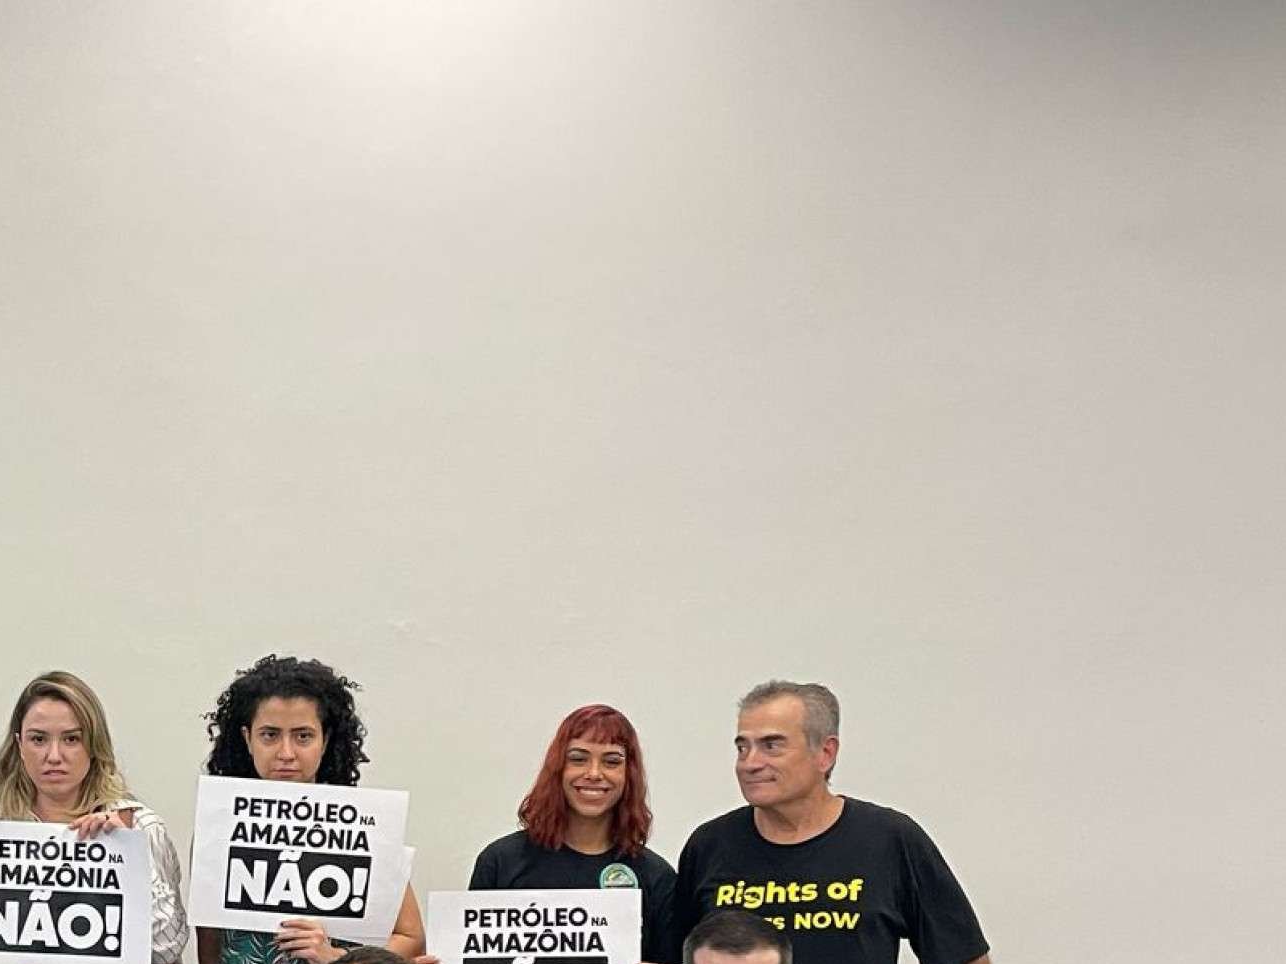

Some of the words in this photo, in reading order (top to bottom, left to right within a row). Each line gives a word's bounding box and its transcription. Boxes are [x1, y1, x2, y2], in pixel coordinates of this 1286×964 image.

[233, 796, 358, 824] PETRÓLEO
[360, 816, 376, 826] NA
[231, 822, 370, 851] AMAZÔNIA
[108, 853, 124, 864] NA
[227, 850, 369, 913] NÃO!
[716, 880, 818, 909] Rights
[827, 878, 864, 901] of
[464, 903, 588, 928] PETRÓLEO
[591, 917, 608, 927] NA
[794, 912, 861, 930] NOW
[463, 929, 605, 954] AMAZÔNIA
